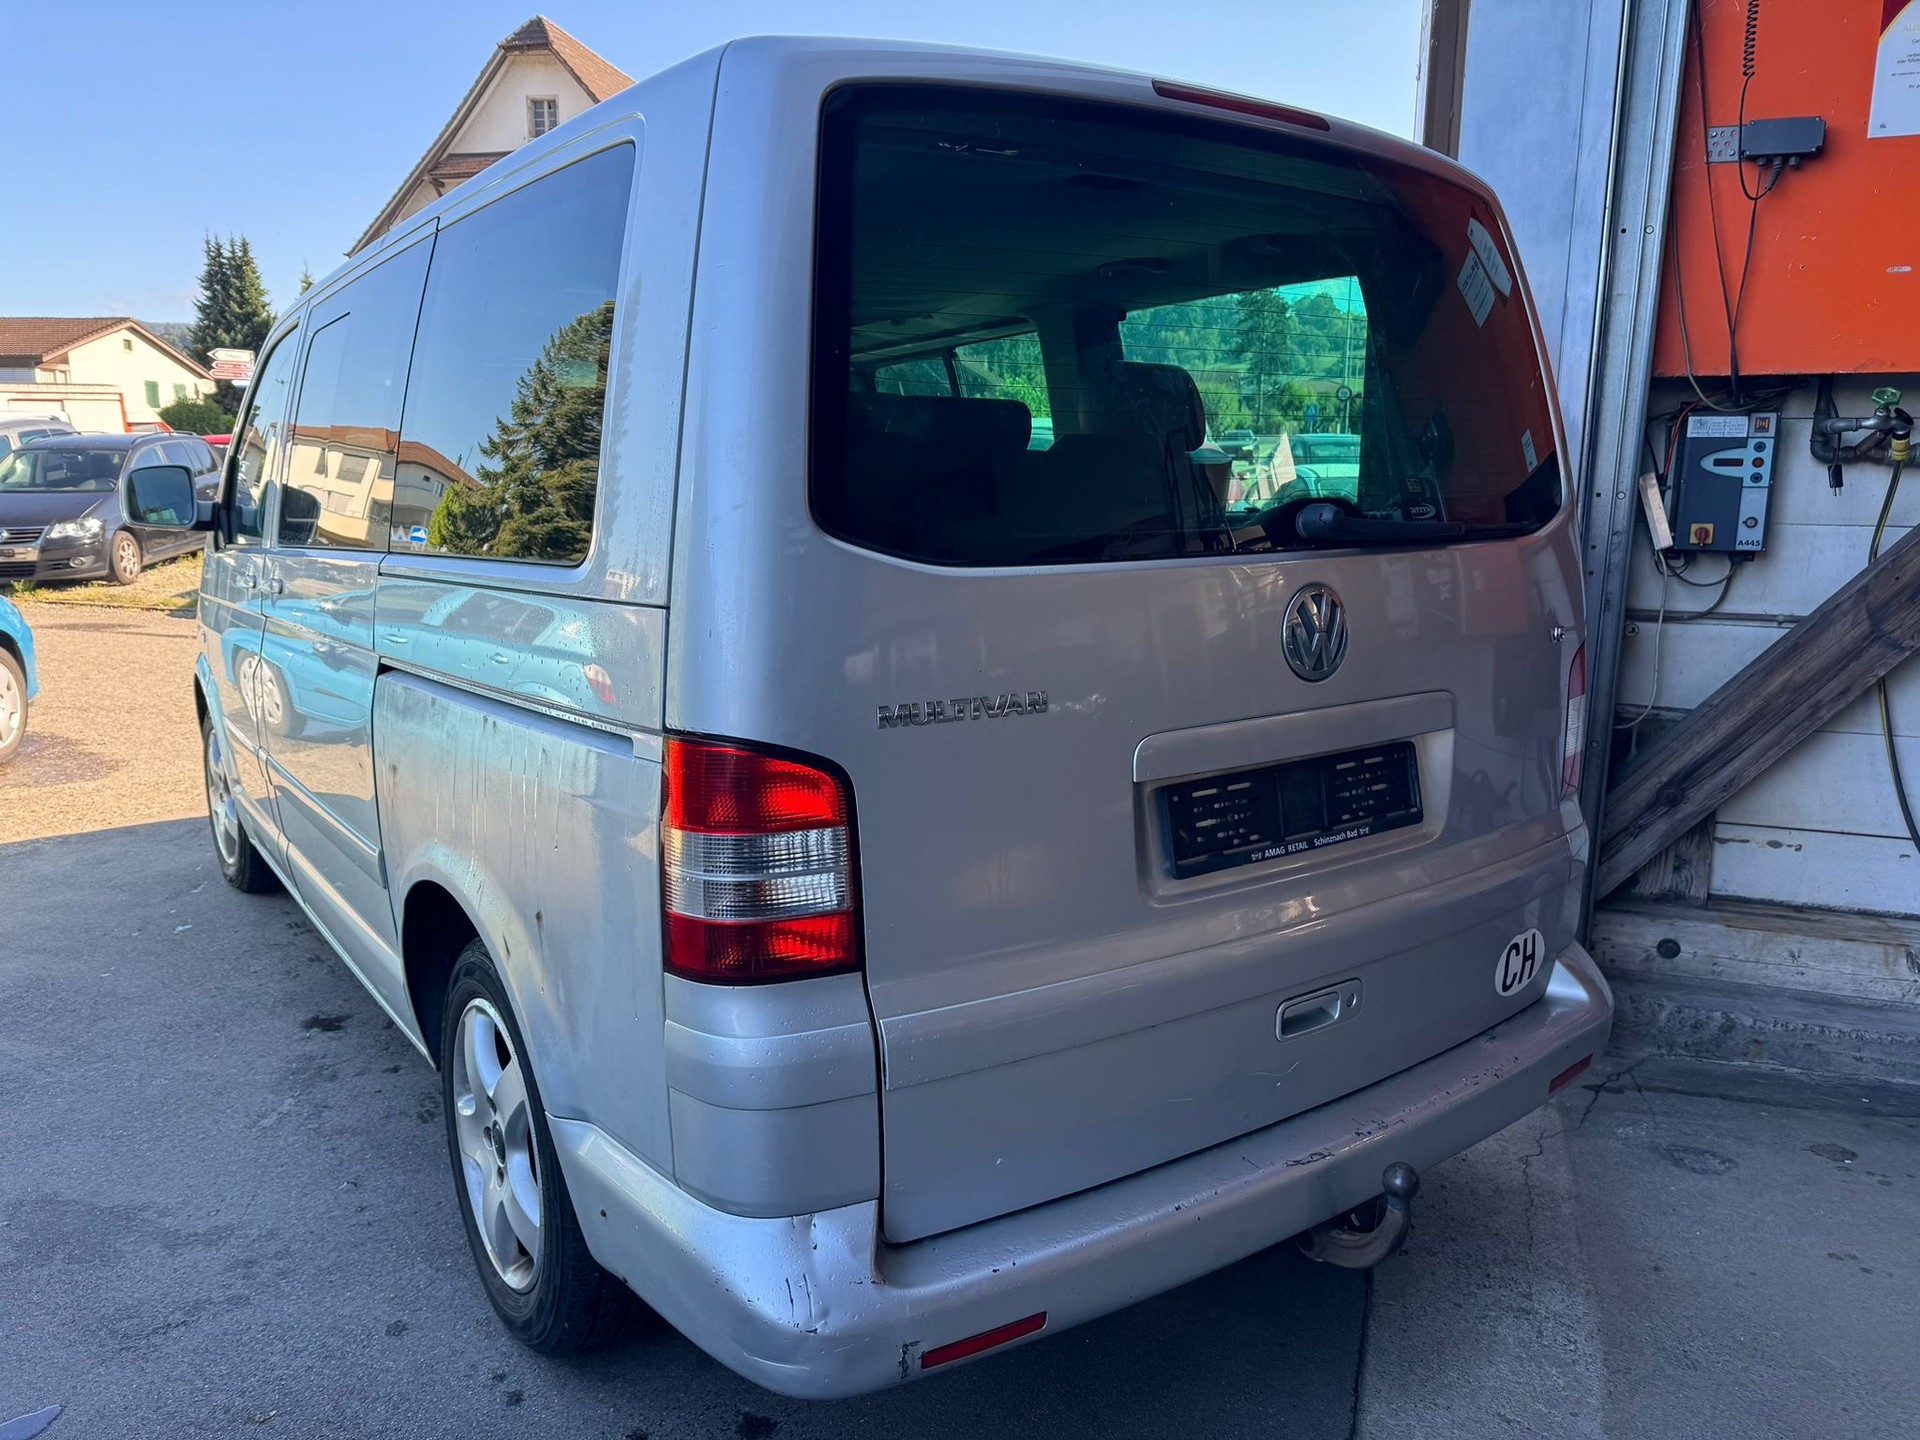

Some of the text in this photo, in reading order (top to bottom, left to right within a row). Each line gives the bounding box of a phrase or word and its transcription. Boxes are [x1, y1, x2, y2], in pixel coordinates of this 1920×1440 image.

[1737, 539, 1761, 547] A445
[876, 690, 1048, 729] MULTIVAN
[1264, 827, 1358, 859] AMAG RETAIL Schinznach Bad
[1501, 931, 1537, 993] CH
